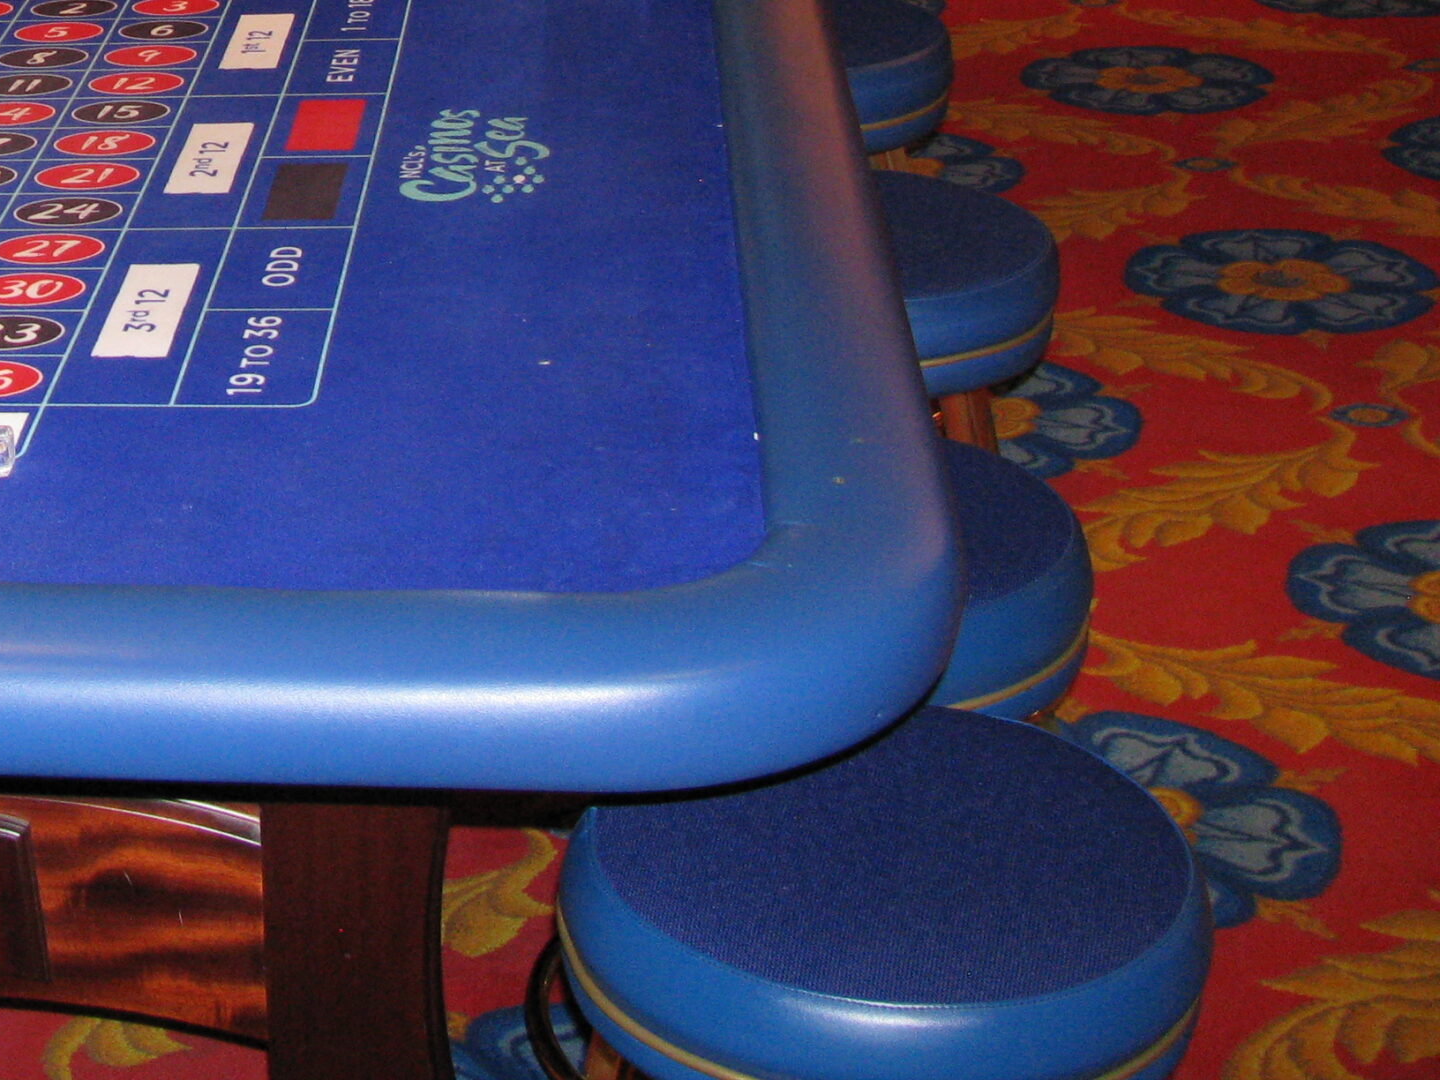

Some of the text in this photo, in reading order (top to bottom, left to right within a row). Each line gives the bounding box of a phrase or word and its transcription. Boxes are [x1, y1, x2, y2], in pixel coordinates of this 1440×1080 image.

[59, 2, 87, 15] 2
[171, 0, 190, 12] 3
[347, 11, 371, 24] TO
[43, 26, 67, 39] 5
[150, 24, 173, 37] 6
[241, 29, 274, 54] 1st 12
[26, 50, 57, 65] 8
[137, 49, 162, 62] 9
[326, 48, 361, 83] EVEN
[8, 78, 41, 92] 11
[112, 77, 155, 90] 12
[95, 104, 141, 119] 15
[80, 134, 131, 151] 18
[473, 116, 550, 173] AT Sea
[189, 141, 229, 178] 2nd 12
[399, 109, 481, 202] Casinos
[61, 167, 113, 184] 21
[35, 202, 100, 220] 24
[12, 239, 81, 258] 27
[262, 245, 303, 288] ODD
[122, 288, 171, 334] 3rd 12
[225, 315, 284, 396] 19 TO 36
